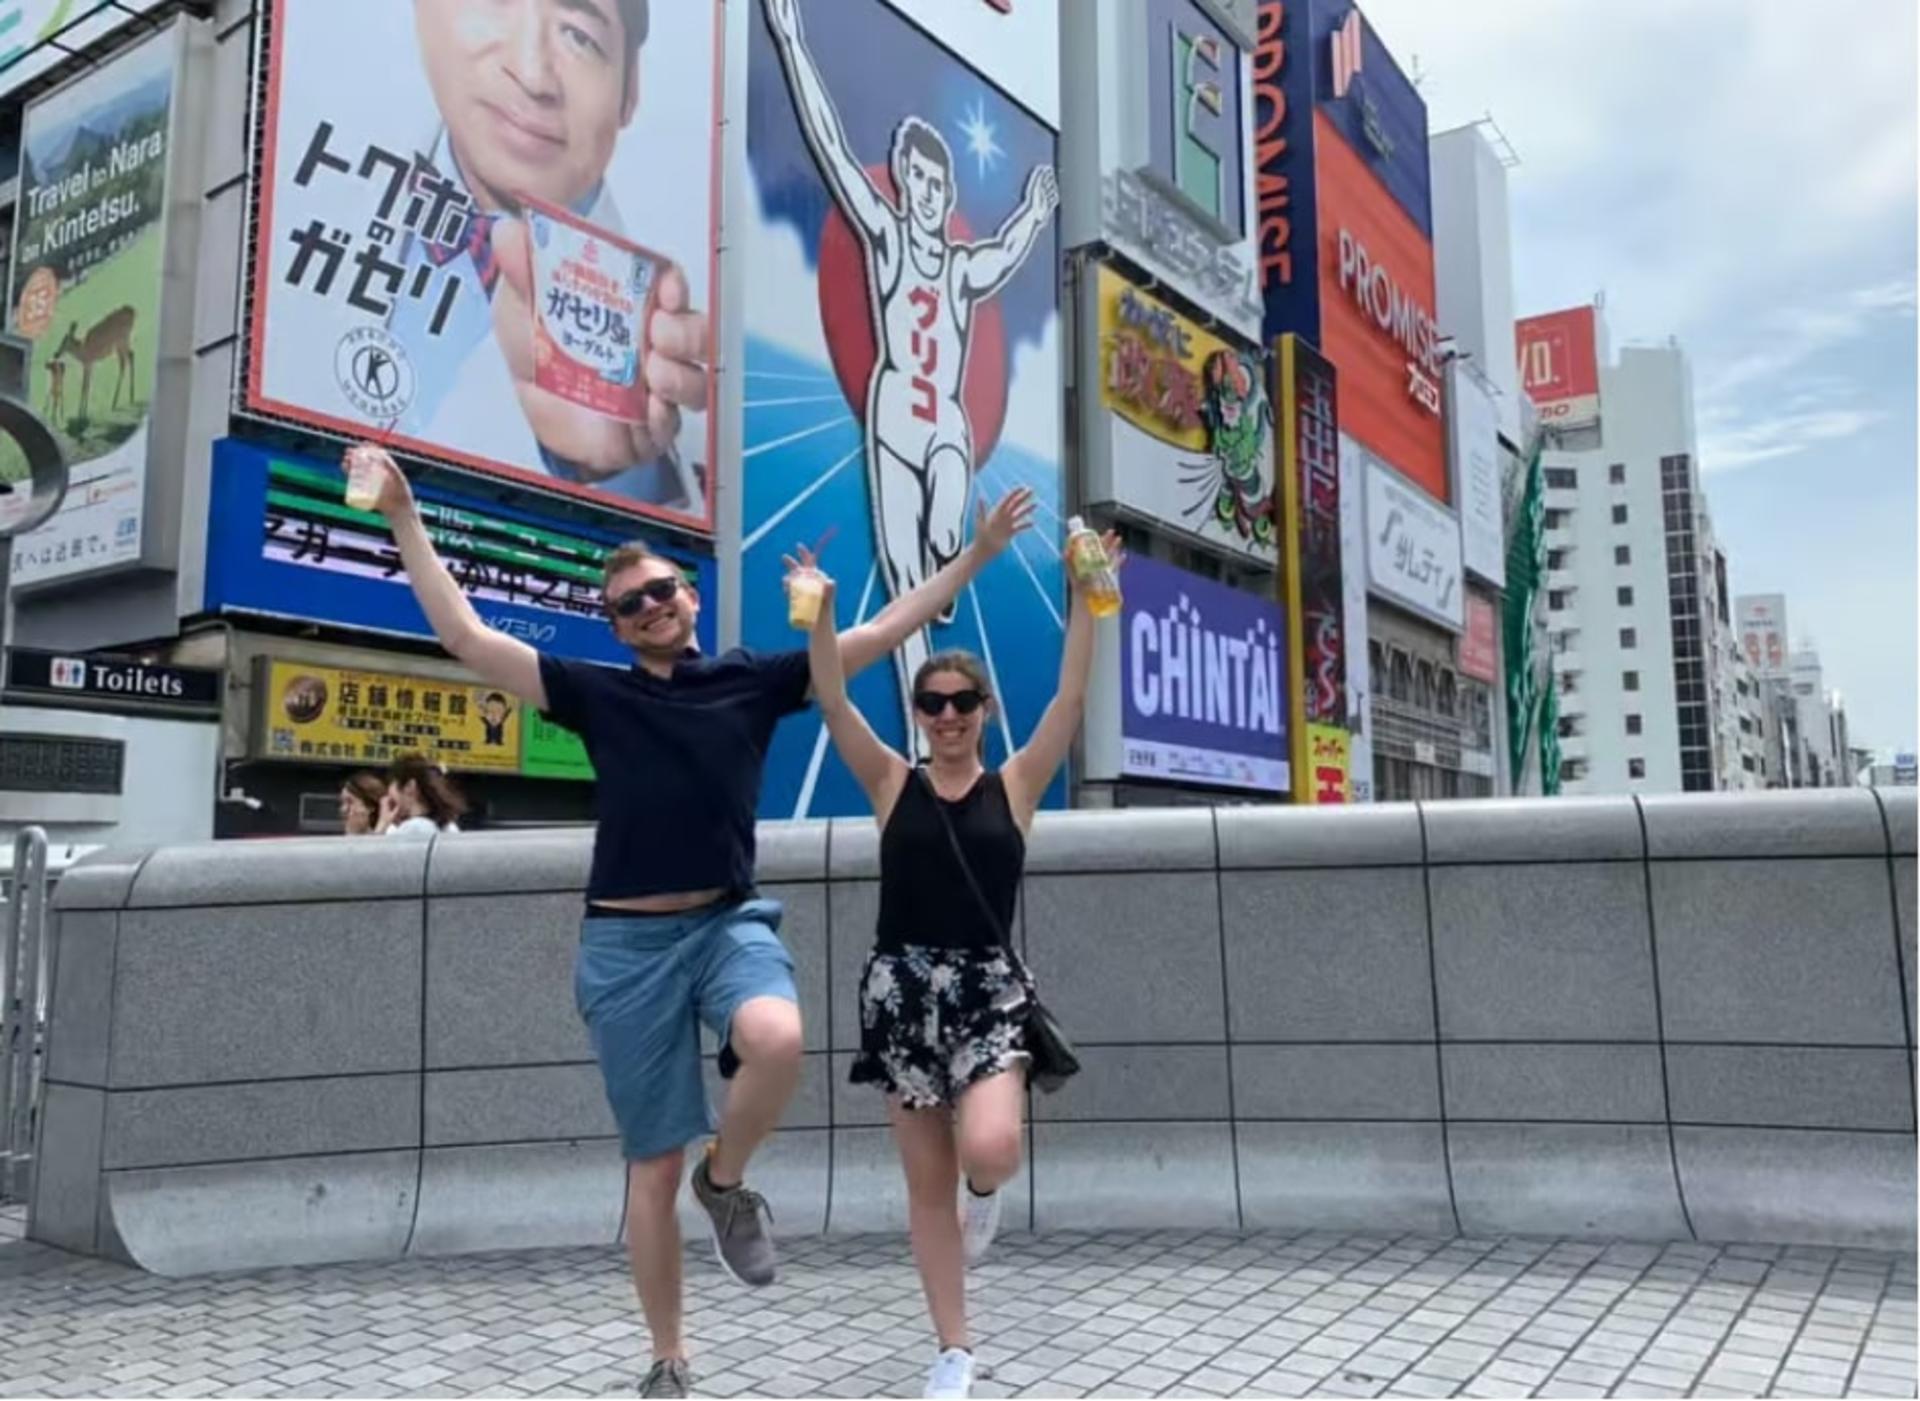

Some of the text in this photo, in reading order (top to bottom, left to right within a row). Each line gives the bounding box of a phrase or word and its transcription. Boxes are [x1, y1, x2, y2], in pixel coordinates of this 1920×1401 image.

[27, 131, 162, 218] Travel to Nara
[294, 121, 472, 248] トクホ
[43, 192, 140, 253] Kintetsu.
[368, 221, 395, 245] の
[285, 221, 461, 336] ガセリ
[908, 286, 939, 425] グリコ
[93, 665, 183, 696] Toilets
